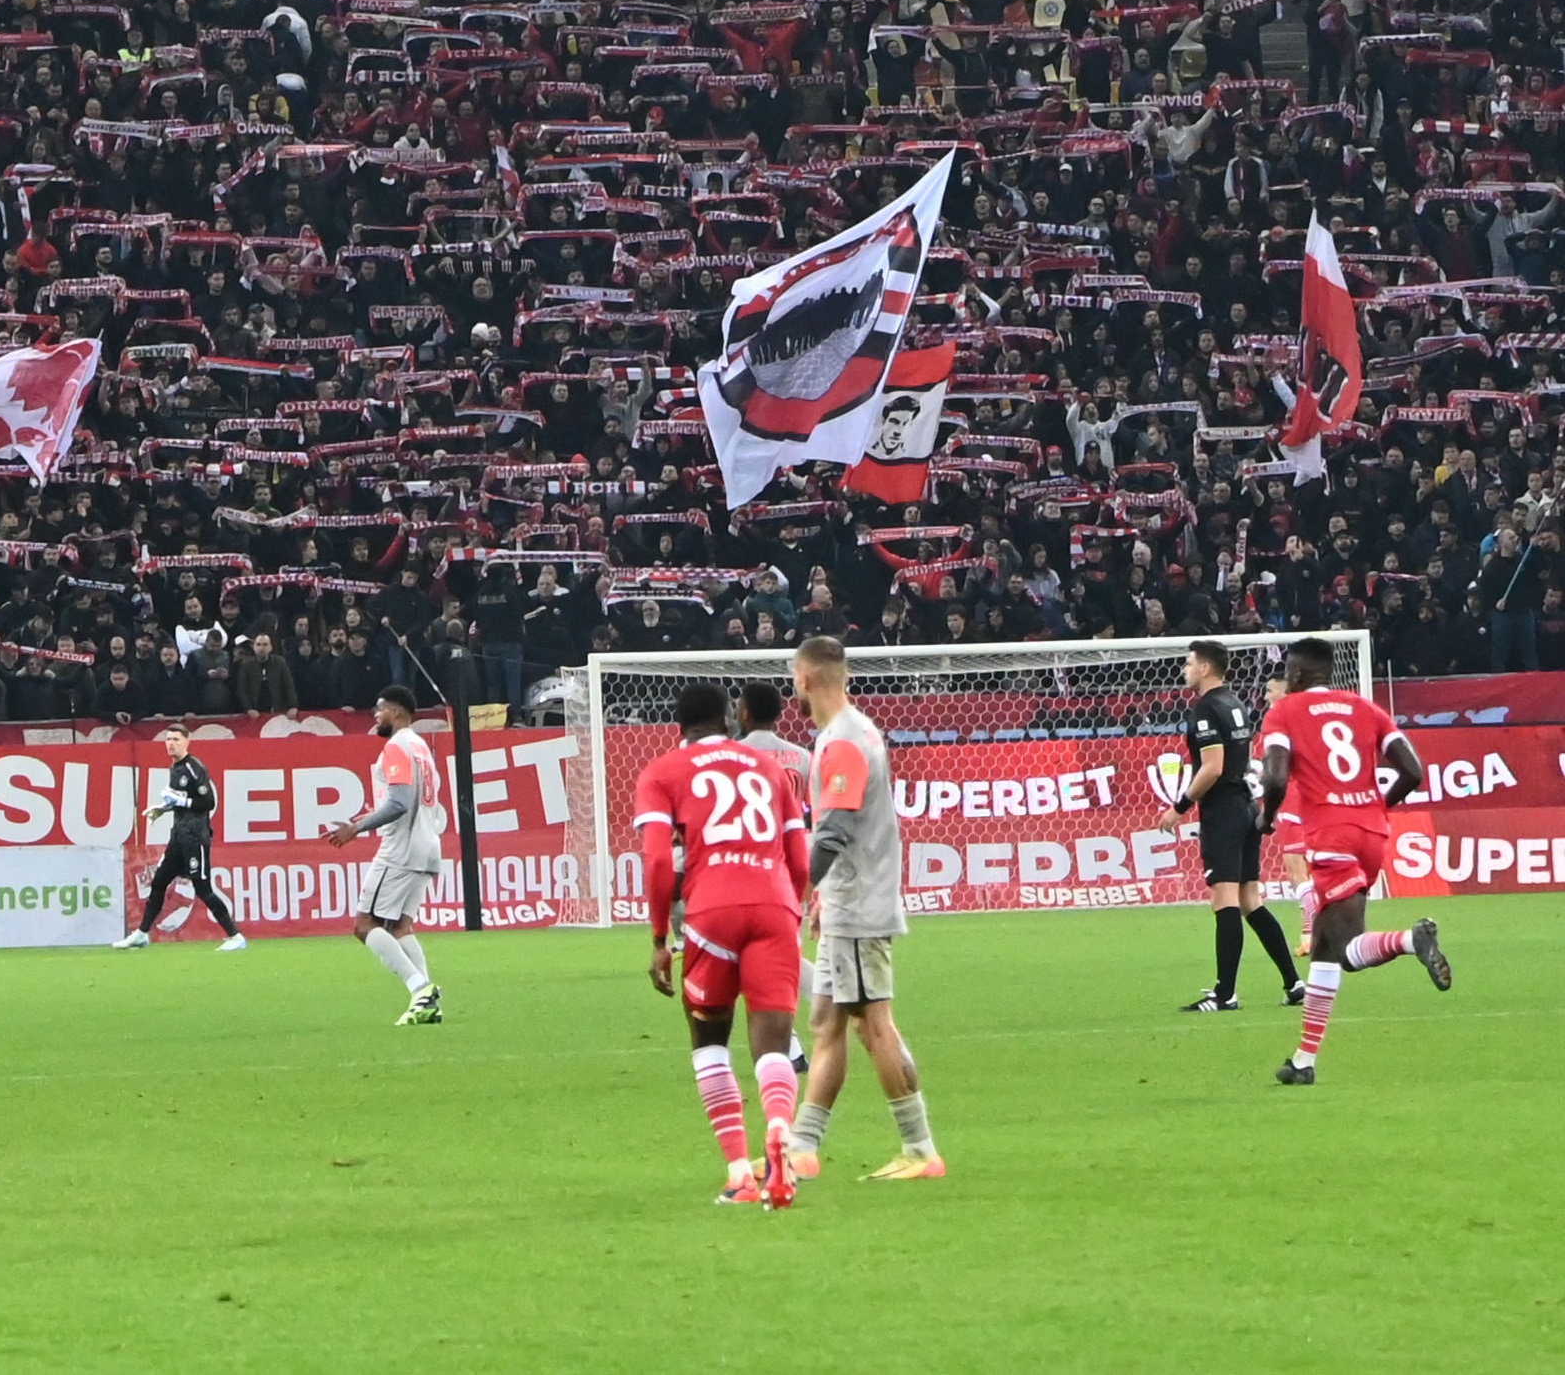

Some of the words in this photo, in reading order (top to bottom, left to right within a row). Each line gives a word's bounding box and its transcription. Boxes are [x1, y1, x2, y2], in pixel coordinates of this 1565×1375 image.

[377, 70, 421, 83] RCH
[1142, 91, 1202, 107] DINAMO
[237, 123, 293, 136] DINAMO
[643, 185, 686, 197] RCH
[283, 400, 360, 412] DINAMO
[573, 482, 620, 495] RCH
[224, 572, 314, 591] DINAMO
[1320, 720, 1362, 783] 8
[891, 766, 1116, 819] UPERBET
[691, 770, 776, 846] 28
[1019, 881, 1154, 907] SUPERBET
